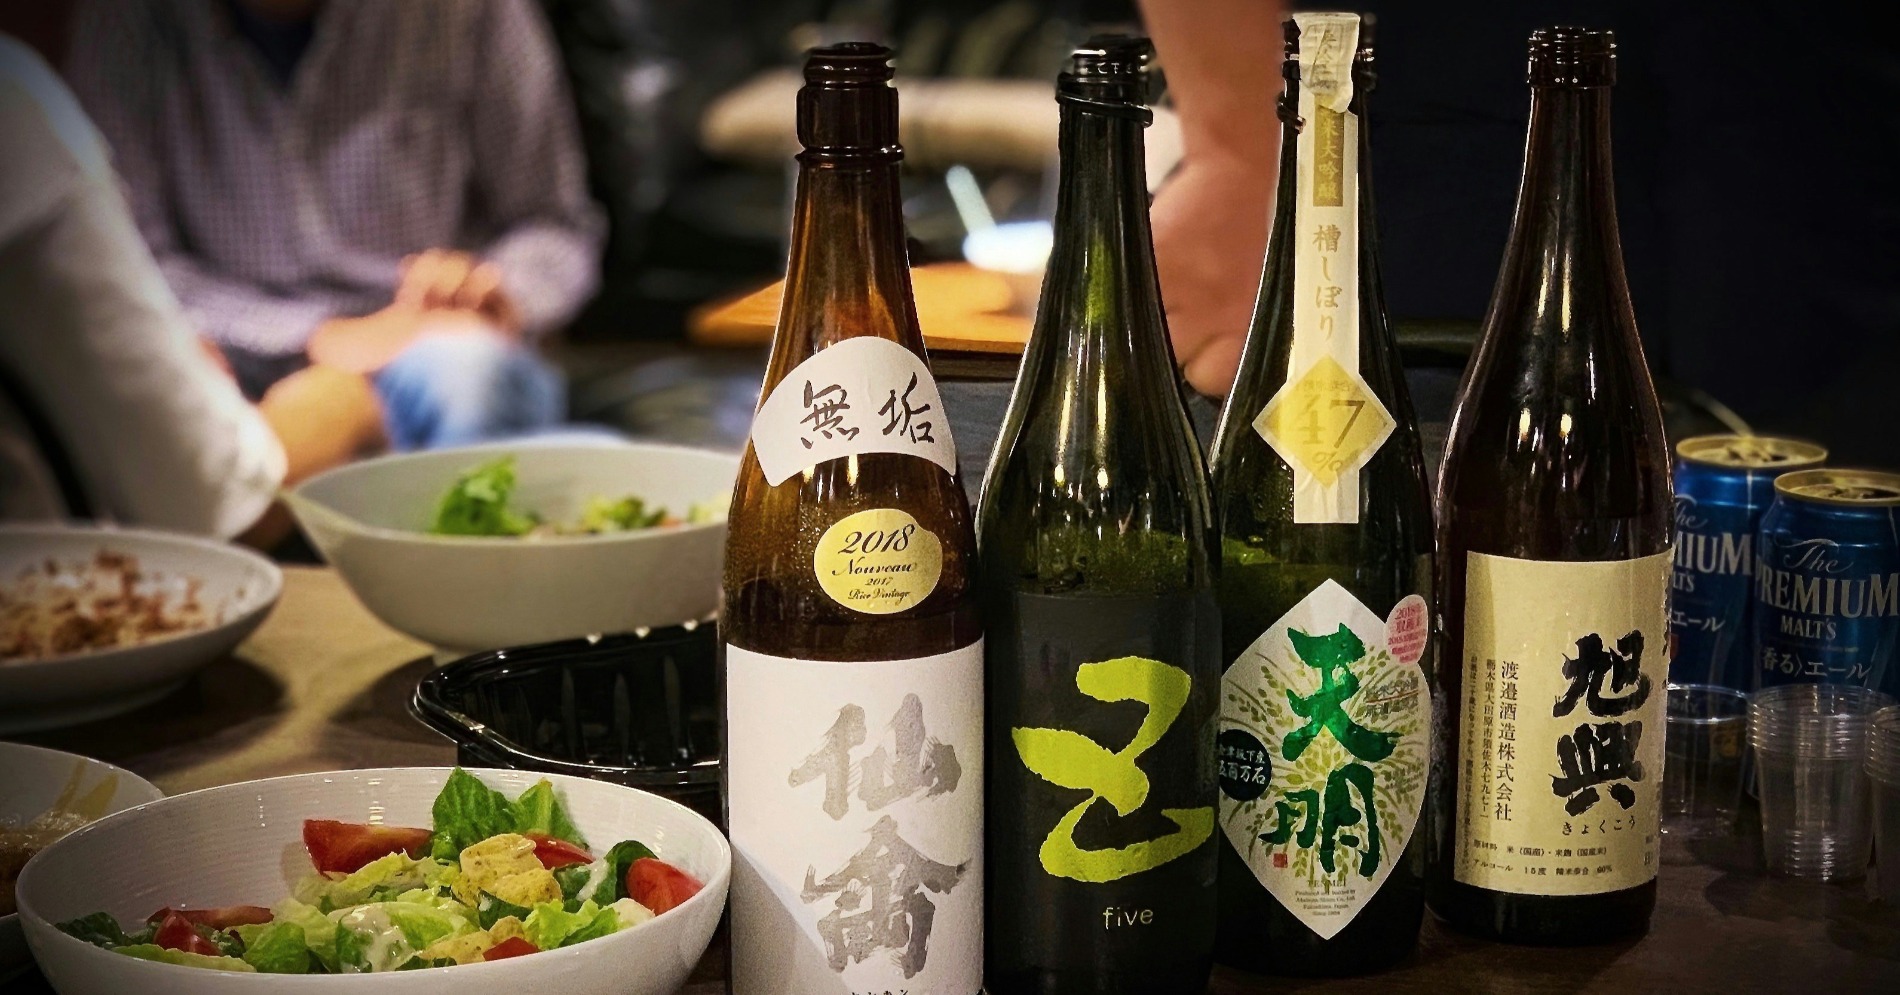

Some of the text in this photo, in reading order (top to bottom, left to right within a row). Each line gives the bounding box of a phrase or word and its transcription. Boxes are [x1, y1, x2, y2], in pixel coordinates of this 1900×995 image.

[1312, 224, 1342, 341] 槽しぼり
[800, 372, 935, 450] 無垢
[838, 524, 916, 554] 2018
[832, 556, 917, 576] Nouveau
[1775, 538, 1854, 574] The
[848, 589, 871, 600] Rice
[865, 577, 893, 586] 2017
[1755, 554, 1900, 619] PREMIUM
[1780, 615, 1837, 640] MALT'S
[1548, 629, 1653, 817] 旭興
[1258, 622, 1404, 880] 天明
[1562, 815, 1636, 836] きょくこう
[1103, 907, 1153, 929] five
